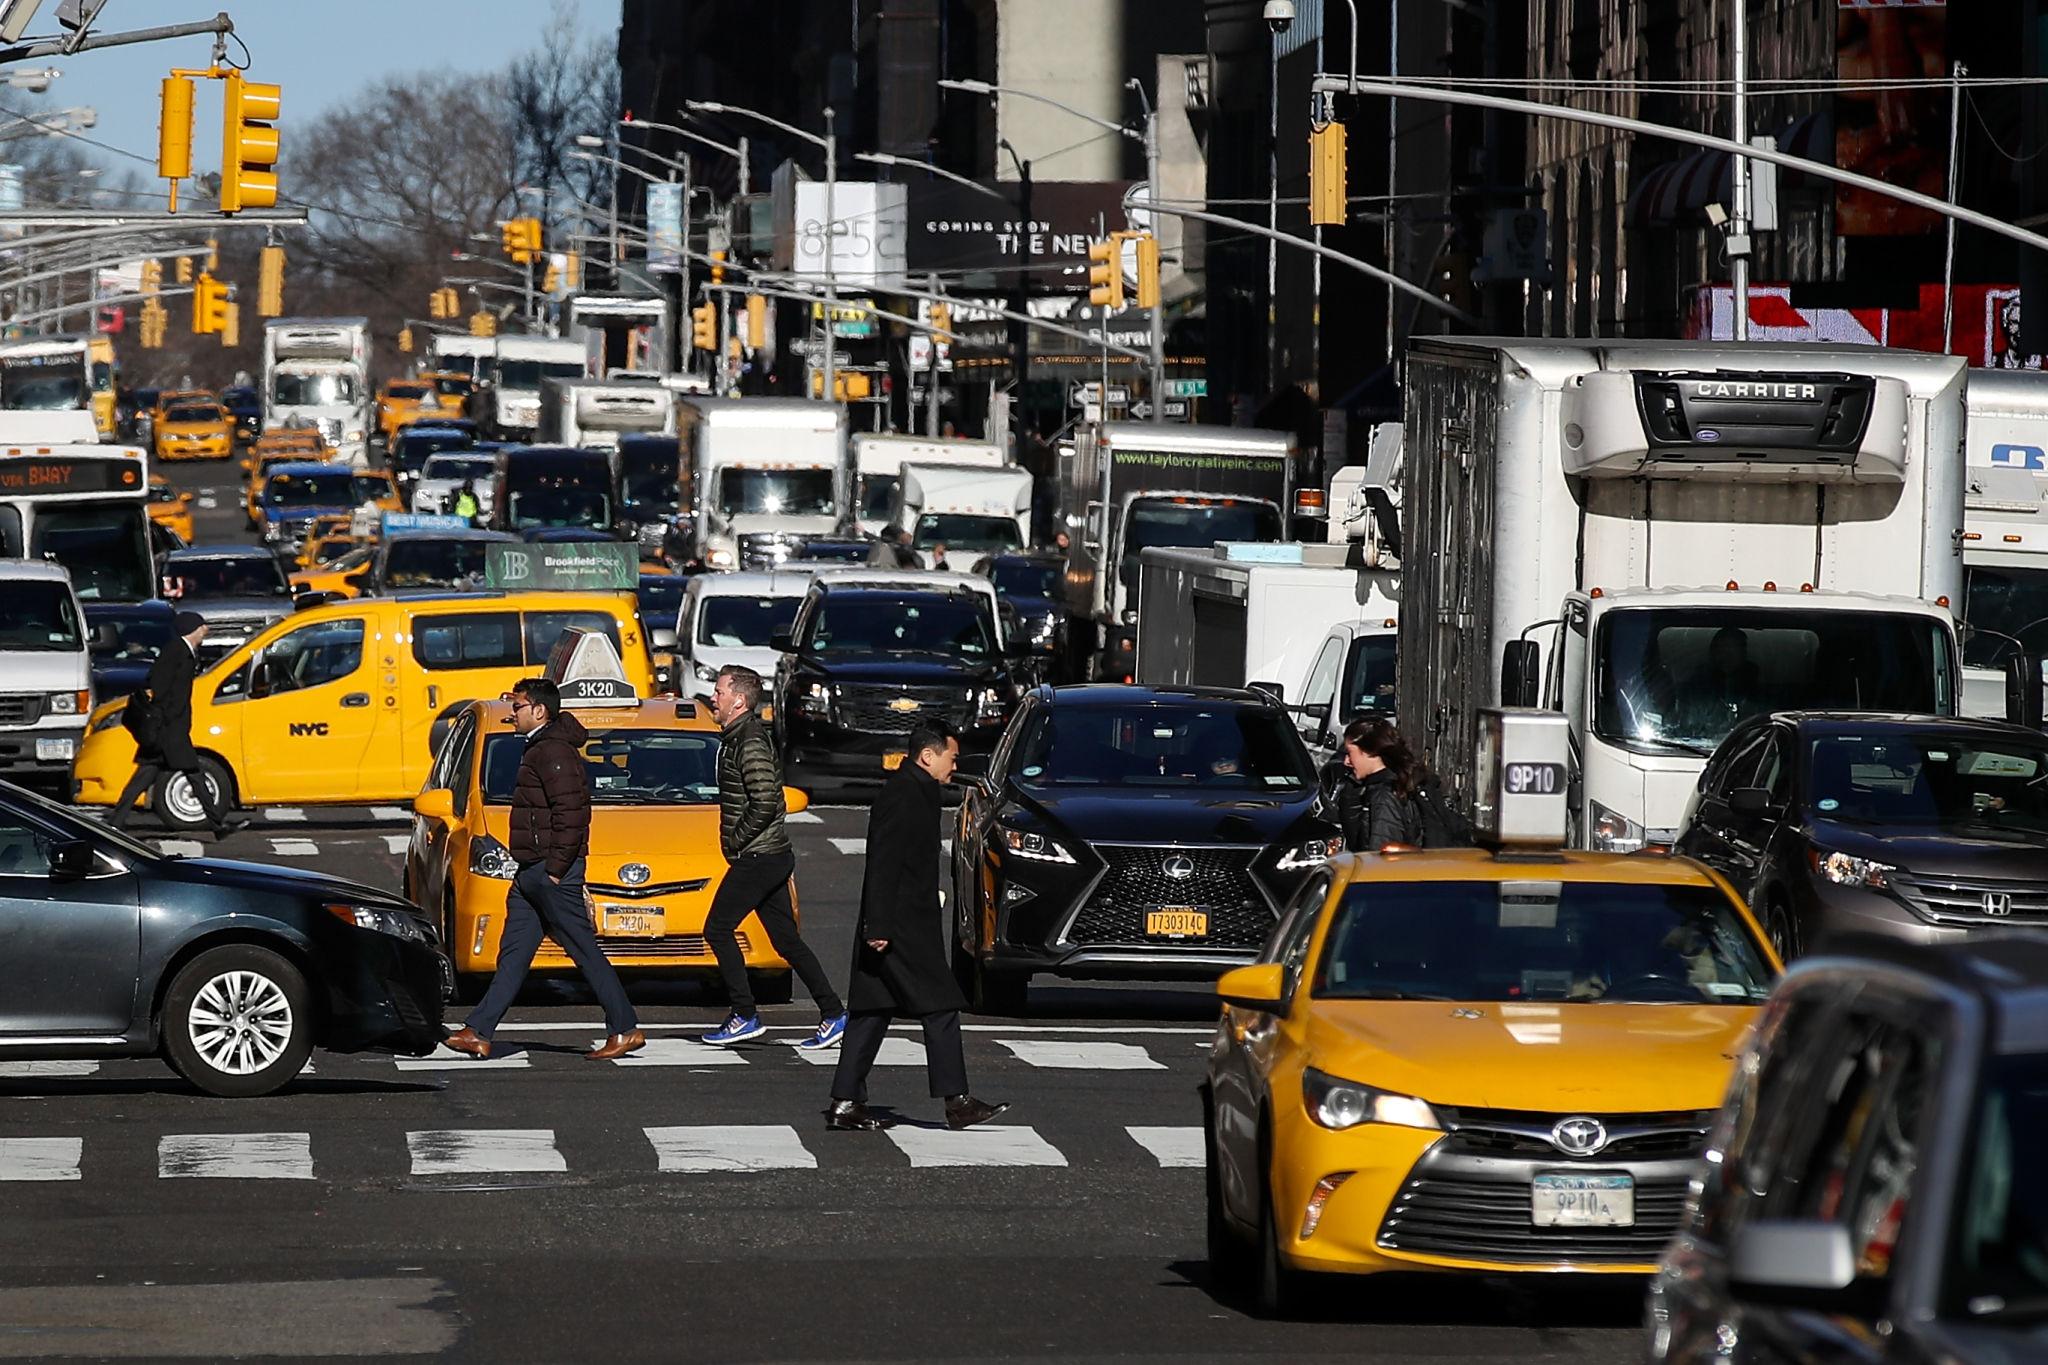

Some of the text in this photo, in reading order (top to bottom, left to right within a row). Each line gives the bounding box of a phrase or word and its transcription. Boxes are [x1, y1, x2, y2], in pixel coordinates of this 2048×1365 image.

[926, 221, 994, 233] COMING
[1697, 383, 1816, 398] CARRIER
[1115, 453, 1282, 472] www.taylorcreativeinc.com
[28, 466, 72, 485] BWAY
[578, 682, 613, 697] 3K20
[289, 722, 329, 736] NYC
[1508, 766, 1555, 792] 9P10
[1151, 914, 1203, 930] T730314C
